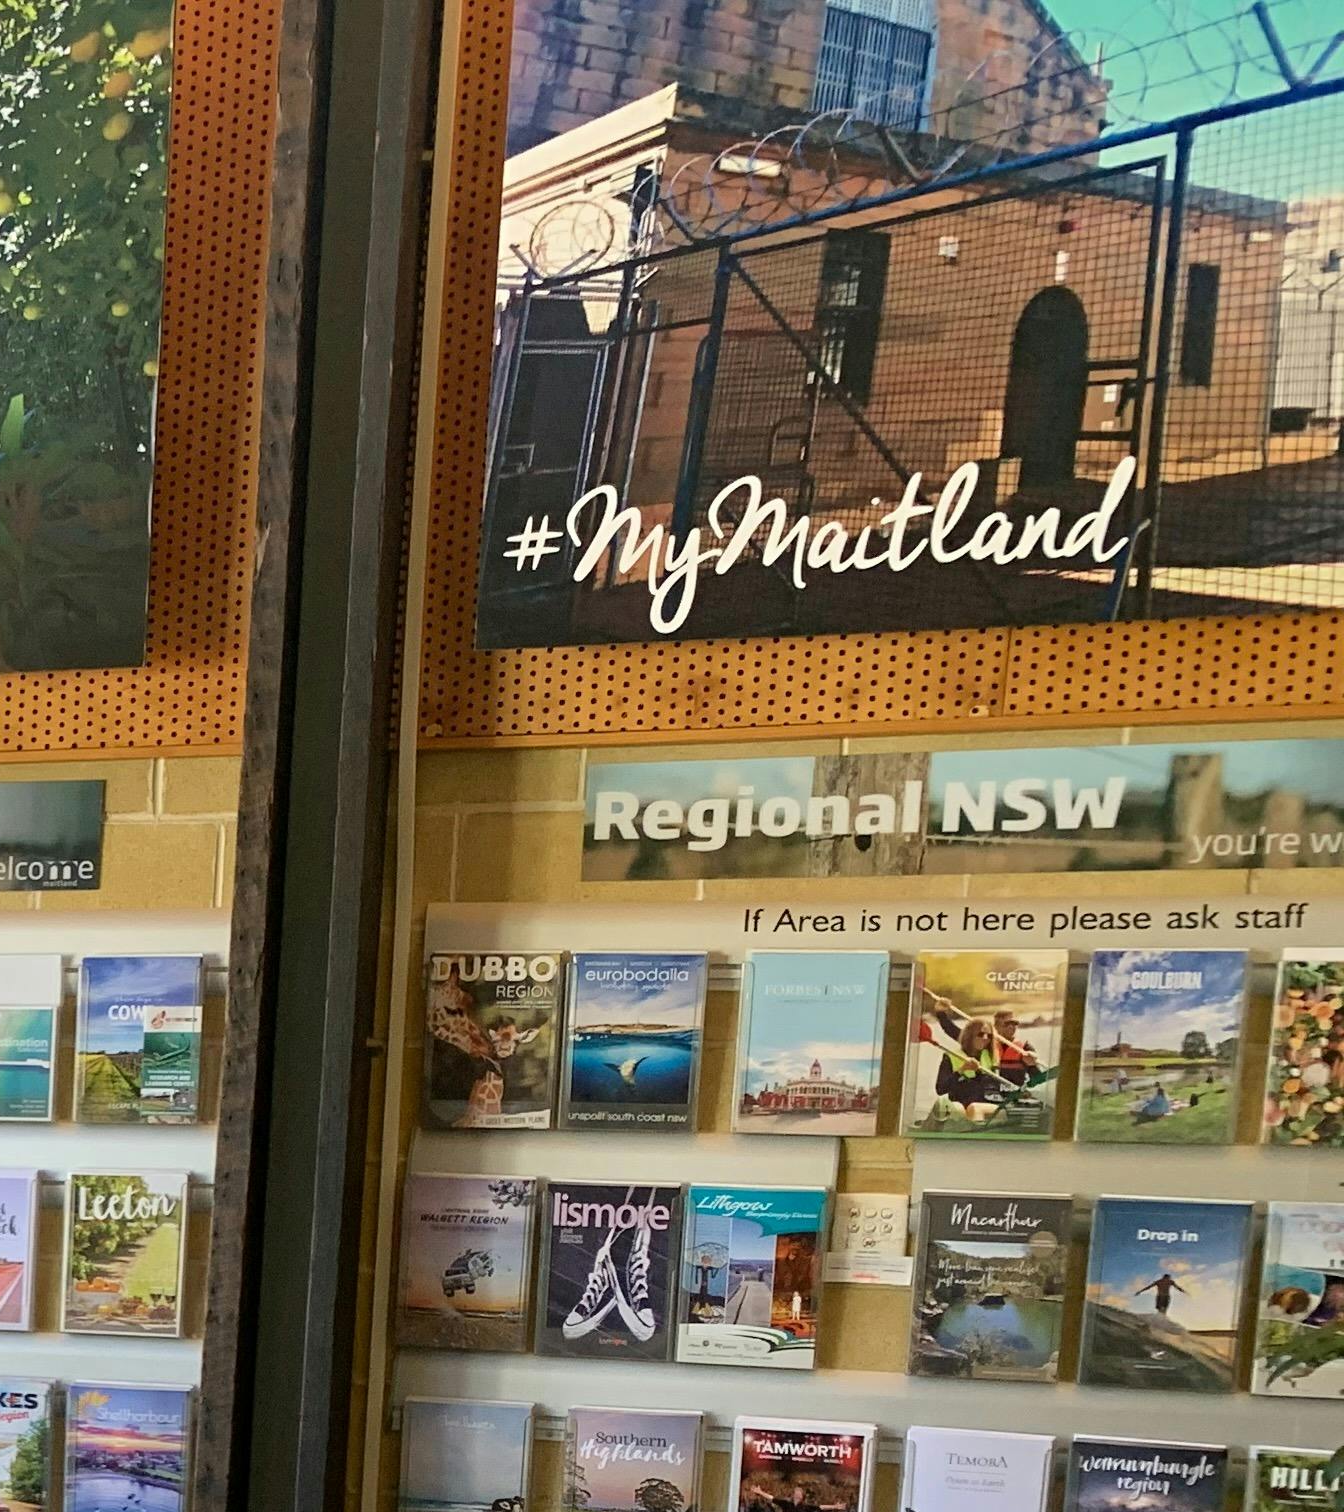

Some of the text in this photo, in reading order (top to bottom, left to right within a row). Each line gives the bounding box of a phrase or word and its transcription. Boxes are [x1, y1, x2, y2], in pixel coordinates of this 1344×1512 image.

[503, 455, 1138, 635] #MyMaitland
[593, 776, 1127, 852] Regional NSW
[1189, 826, 1302, 864] you're
[743, 902, 1310, 938] If Area is not here please ask staff
[431, 954, 557, 983] DUBBO
[584, 967, 690, 984] eurobodalla
[985, 970, 1031, 983] GLEN
[762, 983, 866, 997] FORBES NSW
[1002, 979, 1056, 993] INNES
[1130, 969, 1202, 991] GOULBURN
[495, 985, 554, 999] REGION
[108, 1004, 145, 1022] COW
[78, 1184, 178, 1222] Leeton
[552, 1191, 670, 1232] lismore
[696, 1194, 773, 1217] Lithgow
[469, 1216, 510, 1225] REGION
[950, 1202, 1043, 1231] Macarthur
[1136, 1228, 1199, 1244] Drop in
[96, 1406, 181, 1424] Shellharbour
[595, 1431, 668, 1449] Southern
[753, 1438, 852, 1460] TAMWORTH
[579, 1437, 686, 1470] Highlands
[945, 1451, 1009, 1469] TEMORA
[1117, 1475, 1171, 1501] region
[1270, 1466, 1341, 1492] HILL
